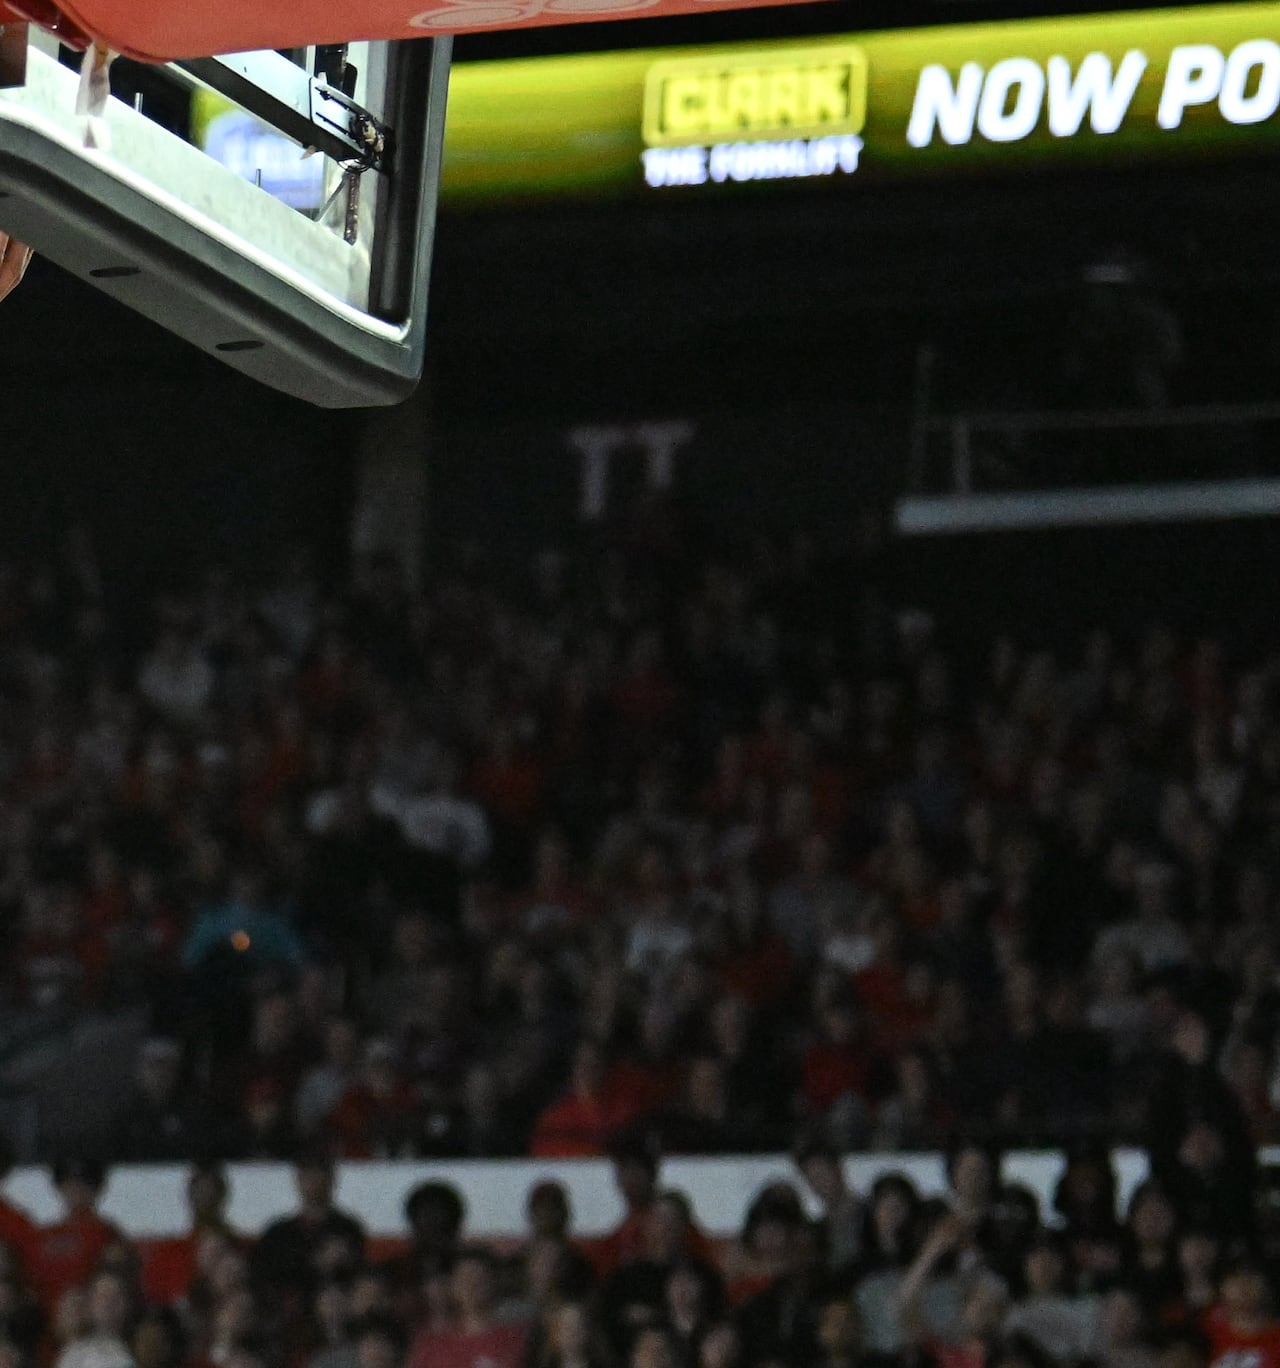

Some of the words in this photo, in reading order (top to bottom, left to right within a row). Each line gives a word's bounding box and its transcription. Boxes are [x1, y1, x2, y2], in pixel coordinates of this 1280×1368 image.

[664, 64, 846, 132] CLARK
[906, 48, 1148, 148] NOW
[1157, 39, 1280, 129] PO
